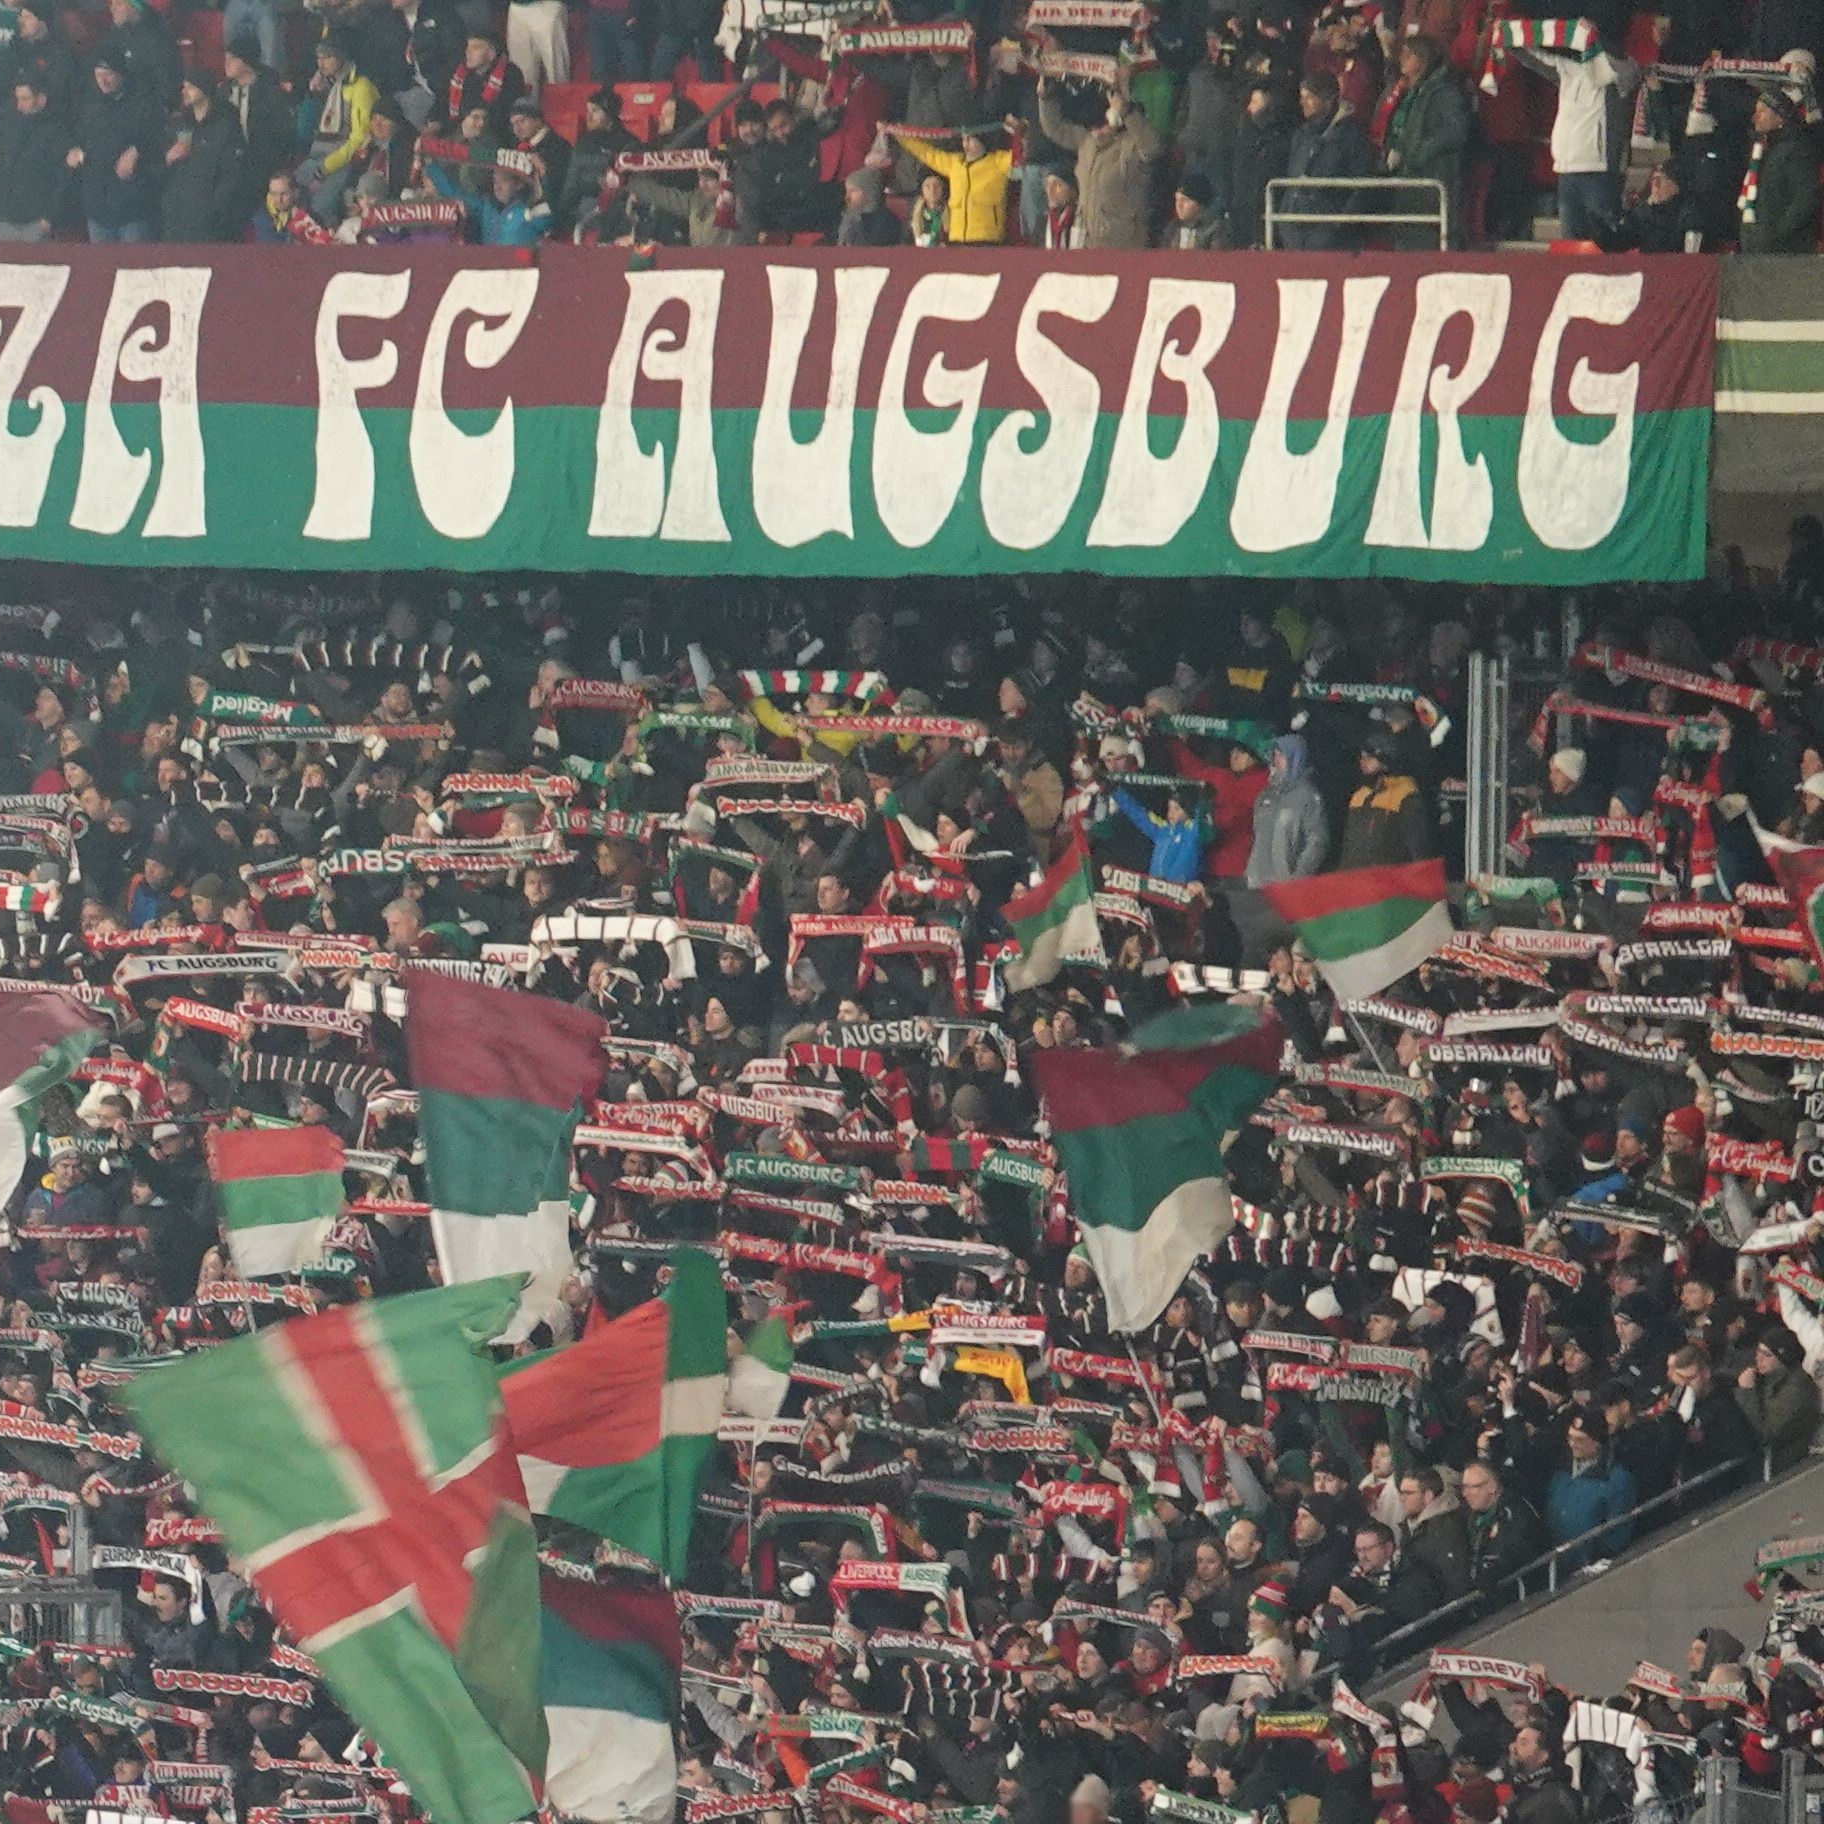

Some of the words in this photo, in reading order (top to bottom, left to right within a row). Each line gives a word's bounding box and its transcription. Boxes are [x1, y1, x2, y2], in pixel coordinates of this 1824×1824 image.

[304, 266, 540, 541] FC
[588, 266, 1644, 556] AUGSBURG
[145, 957, 173, 975] FC
[179, 953, 278, 974] AUGSBURG
[735, 1156, 756, 1176] FC
[760, 1158, 859, 1186] AUGSBURG
